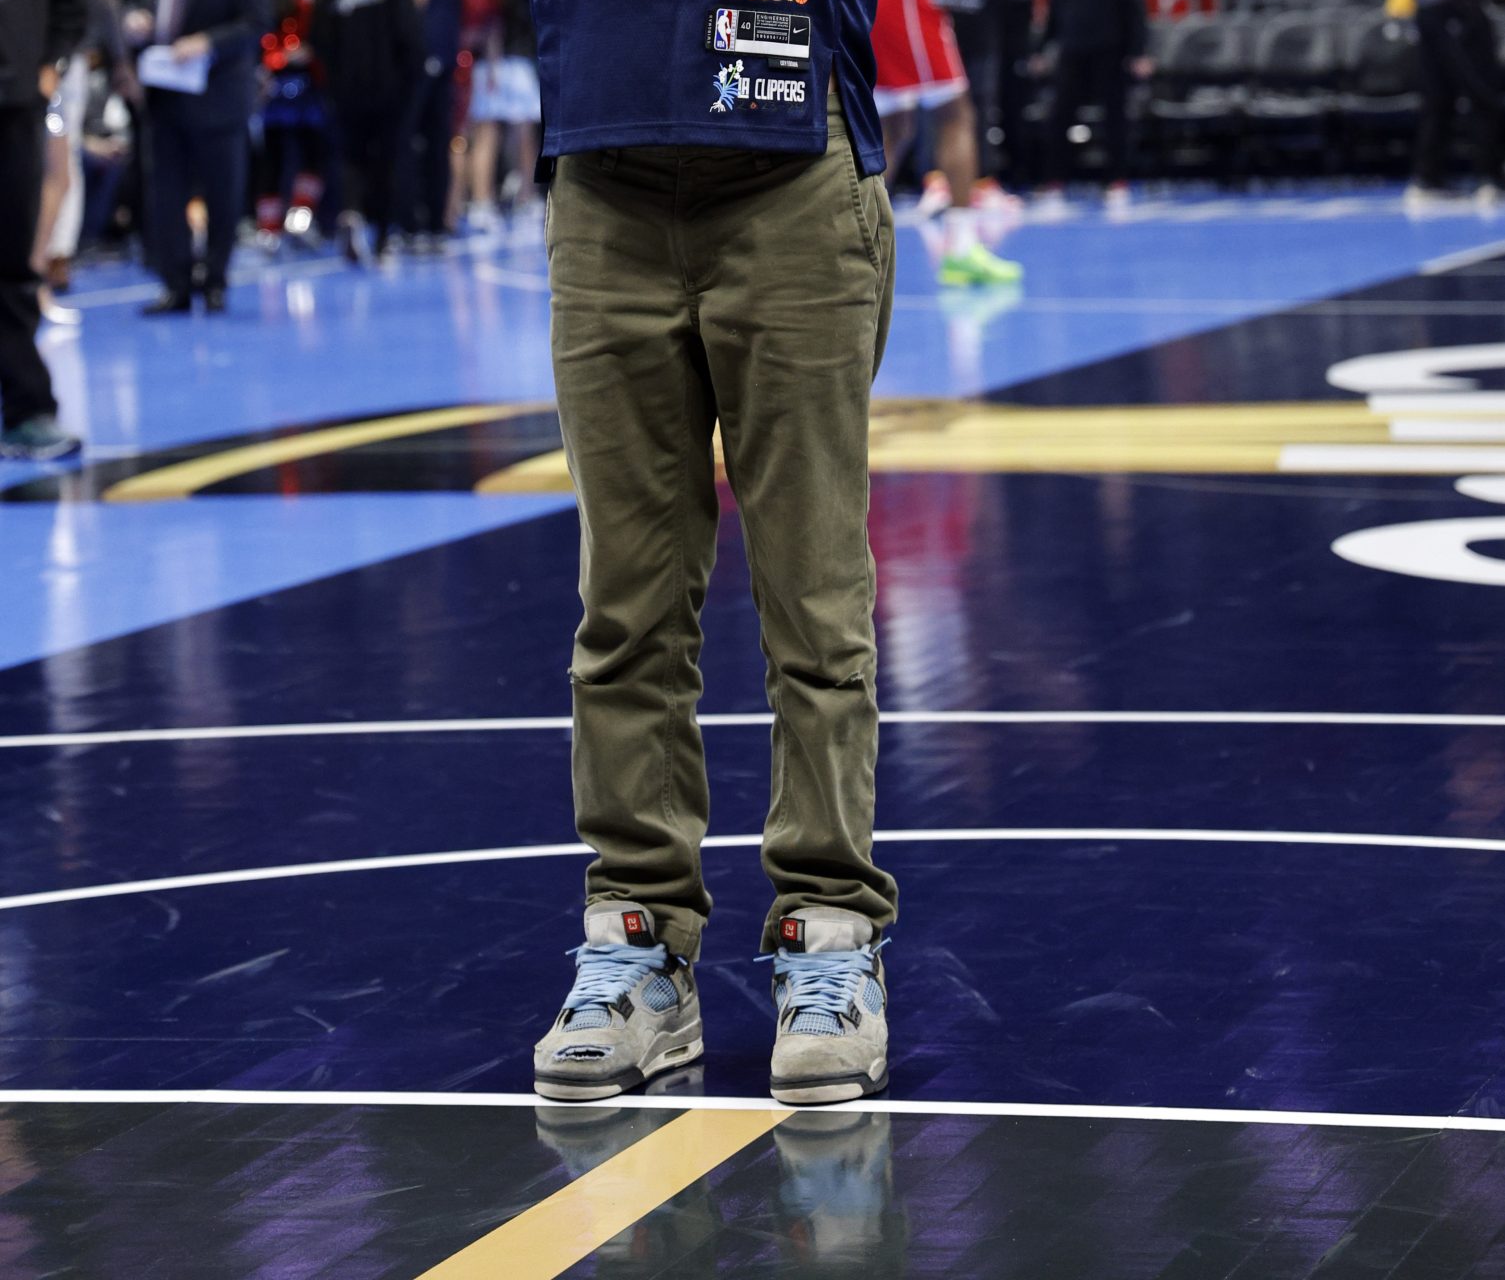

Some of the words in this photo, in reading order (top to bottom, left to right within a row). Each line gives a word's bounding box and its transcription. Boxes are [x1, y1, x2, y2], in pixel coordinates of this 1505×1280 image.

[741, 21, 751, 30] 40
[755, 78, 805, 102] CLIPPERS
[627, 917, 638, 930] 23
[784, 923, 795, 937] 23
